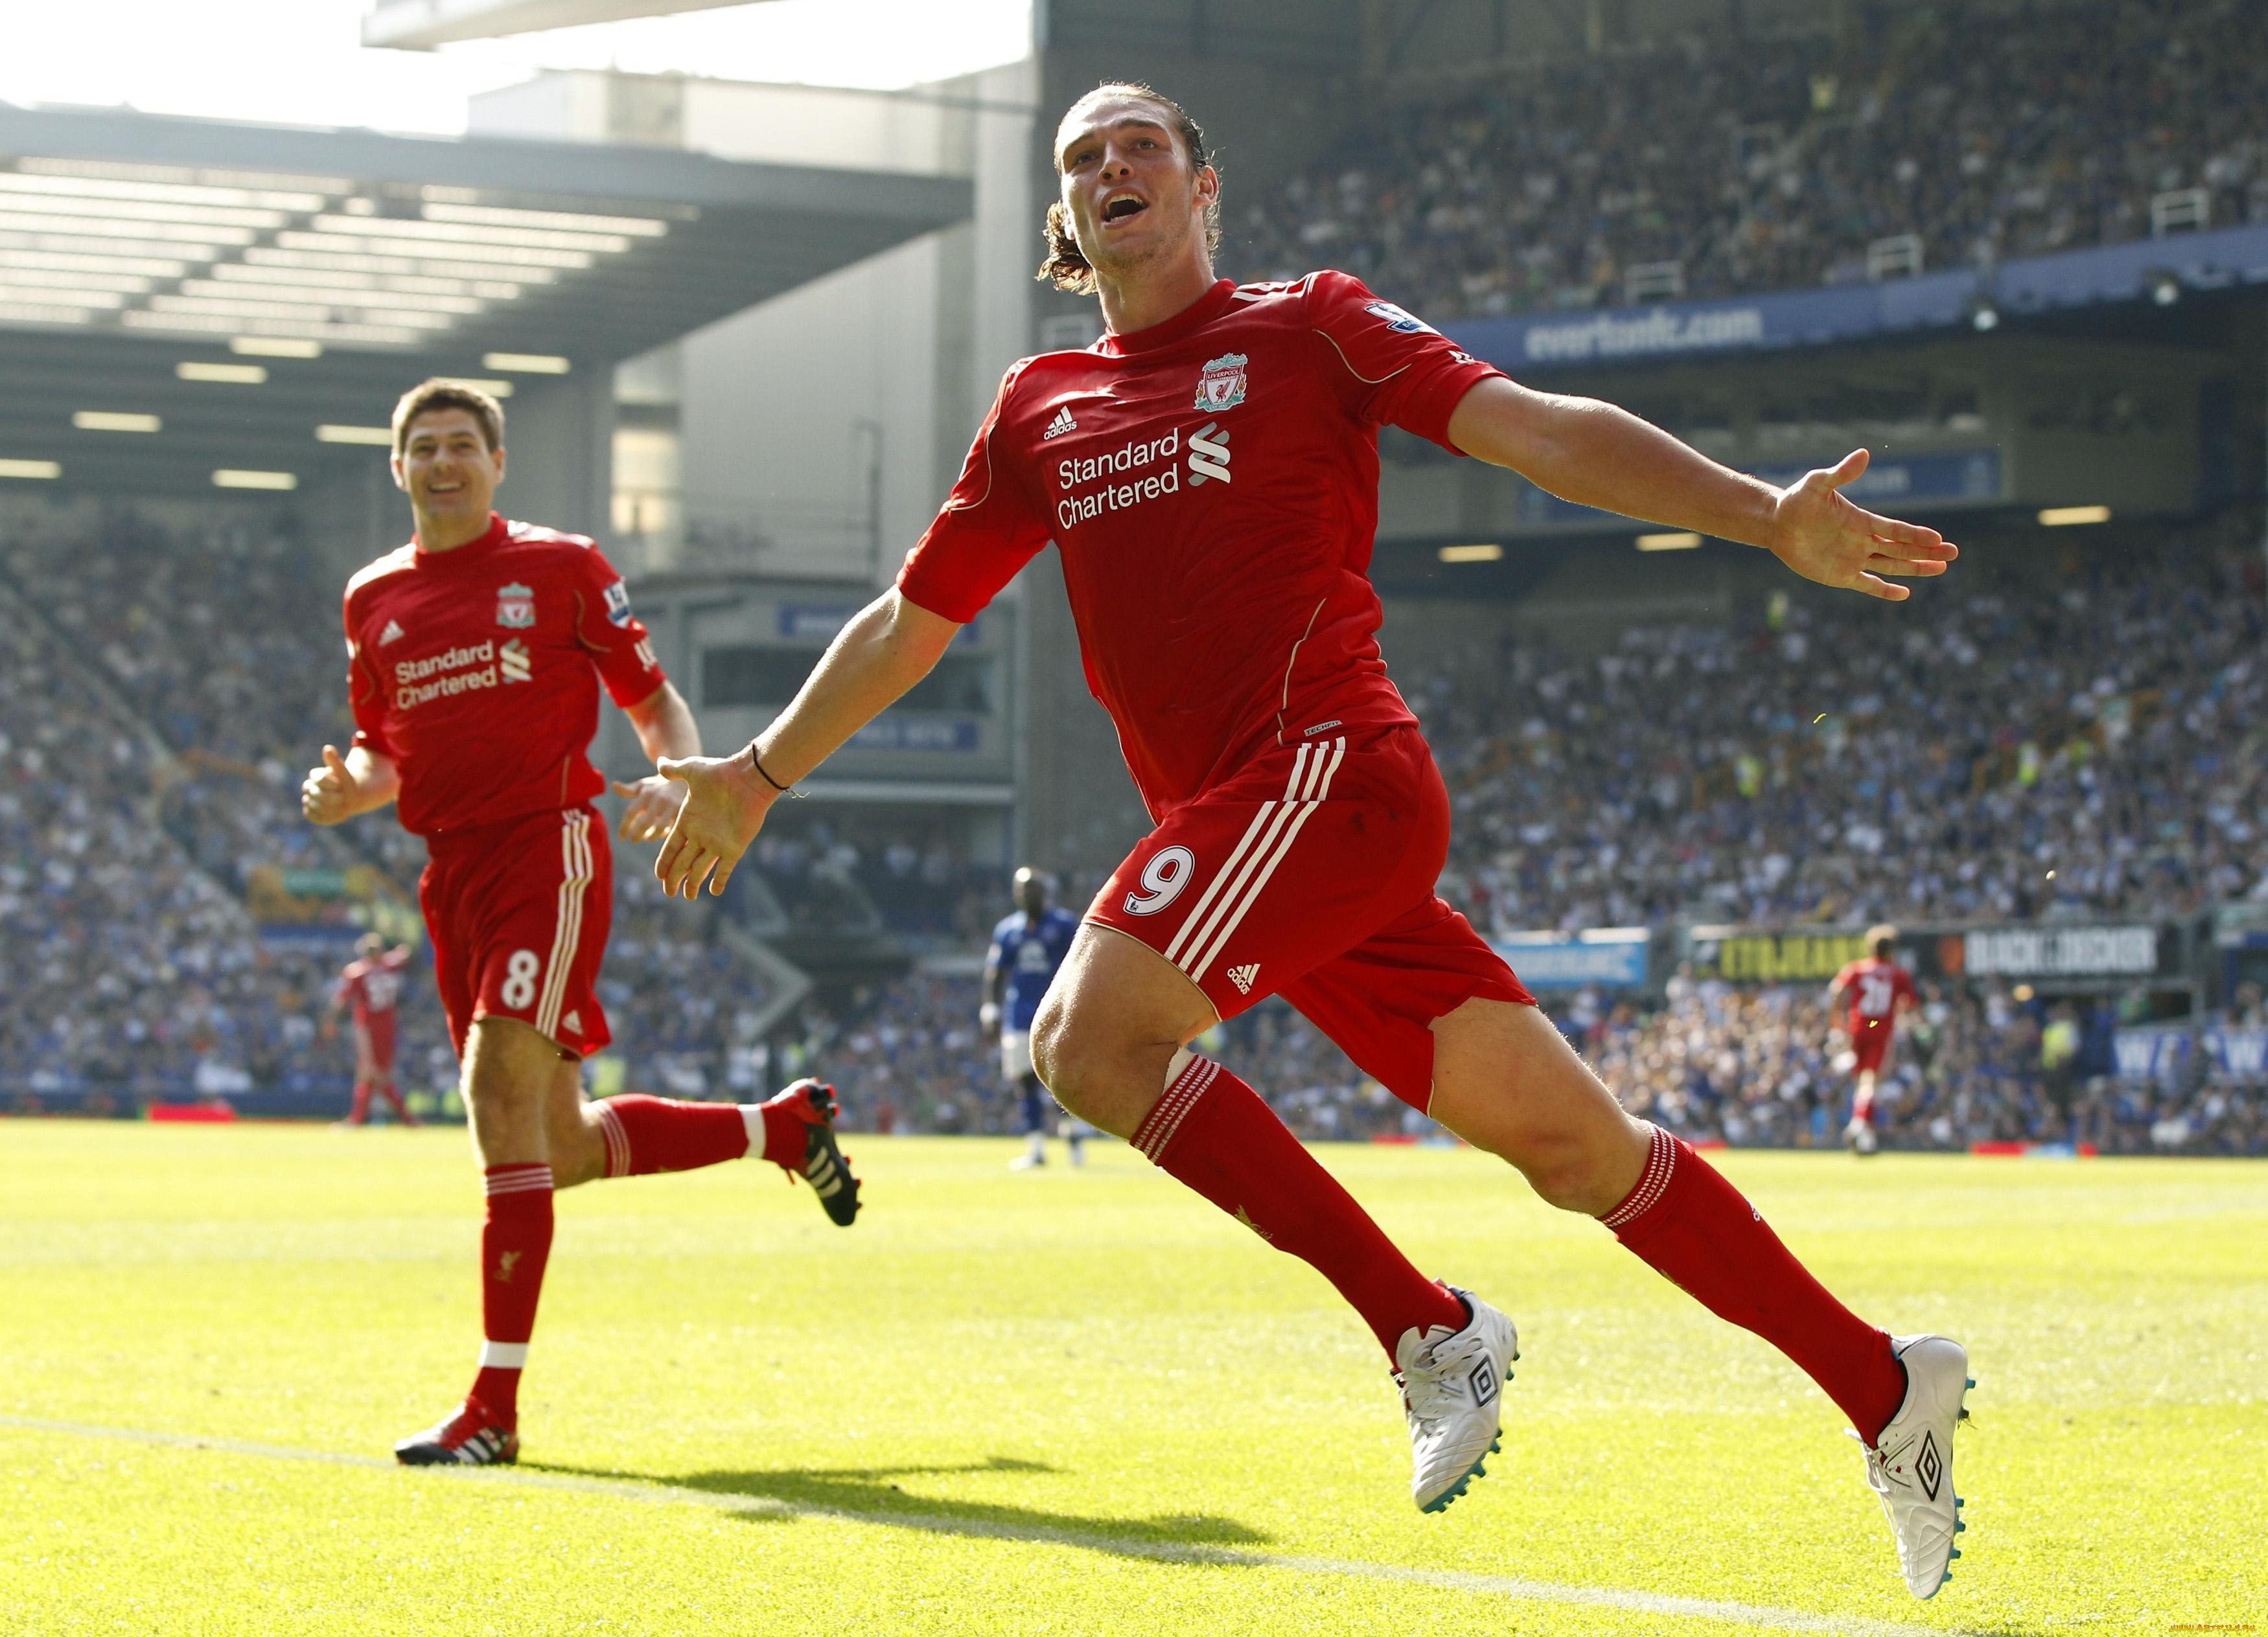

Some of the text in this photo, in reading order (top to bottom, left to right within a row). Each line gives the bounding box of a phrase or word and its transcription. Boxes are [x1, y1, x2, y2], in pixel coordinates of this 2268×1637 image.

[1207, 369, 1240, 380] LIVERPOOL
[1043, 420, 1078, 441] adidas
[1058, 427, 1179, 490] Standard
[1057, 463, 1179, 530] Chartered
[394, 638, 494, 685] Standard
[395, 664, 498, 710] Chartered
[1305, 720, 1340, 735] TECHFIT
[1123, 845, 1196, 917] 9
[501, 948, 540, 1011] 8
[1227, 968, 1251, 995] adidas
